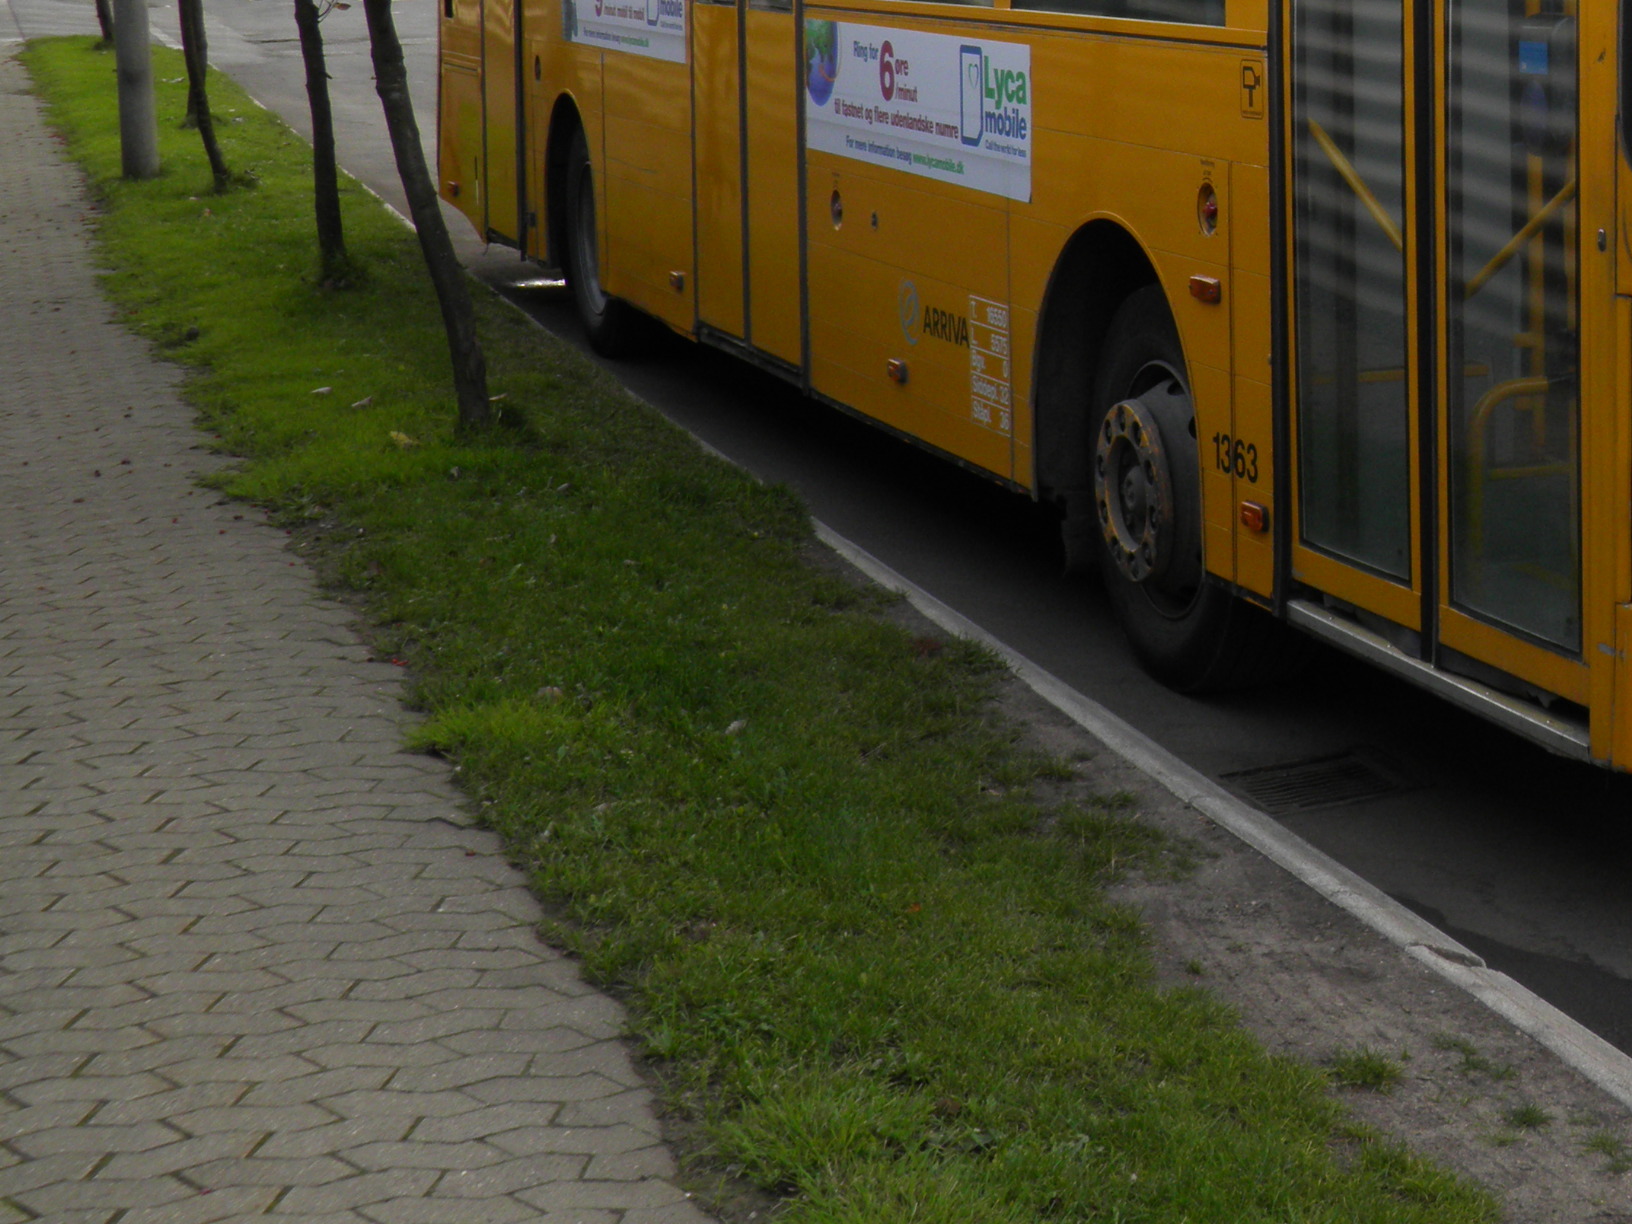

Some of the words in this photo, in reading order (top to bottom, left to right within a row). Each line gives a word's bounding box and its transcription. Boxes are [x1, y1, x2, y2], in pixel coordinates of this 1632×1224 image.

[853, 41, 868, 63] Ring
[869, 43, 878, 61] for
[879, 40, 895, 102] 6
[895, 57, 909, 76] øre
[983, 55, 1027, 110] Lyca
[895, 84, 917, 103] /minut
[842, 99, 864, 120] fastnet
[865, 108, 873, 125] og
[874, 105, 889, 124] flere
[890, 109, 934, 134] udenlandske
[935, 121, 959, 139] numre
[984, 107, 1027, 140] mobile
[846, 135, 854, 147] For
[868, 140, 896, 158] information
[912, 152, 964, 175] www.lycamobile.dk
[923, 305, 970, 349] ARRIVA
[1213, 432, 1258, 484] 1363
